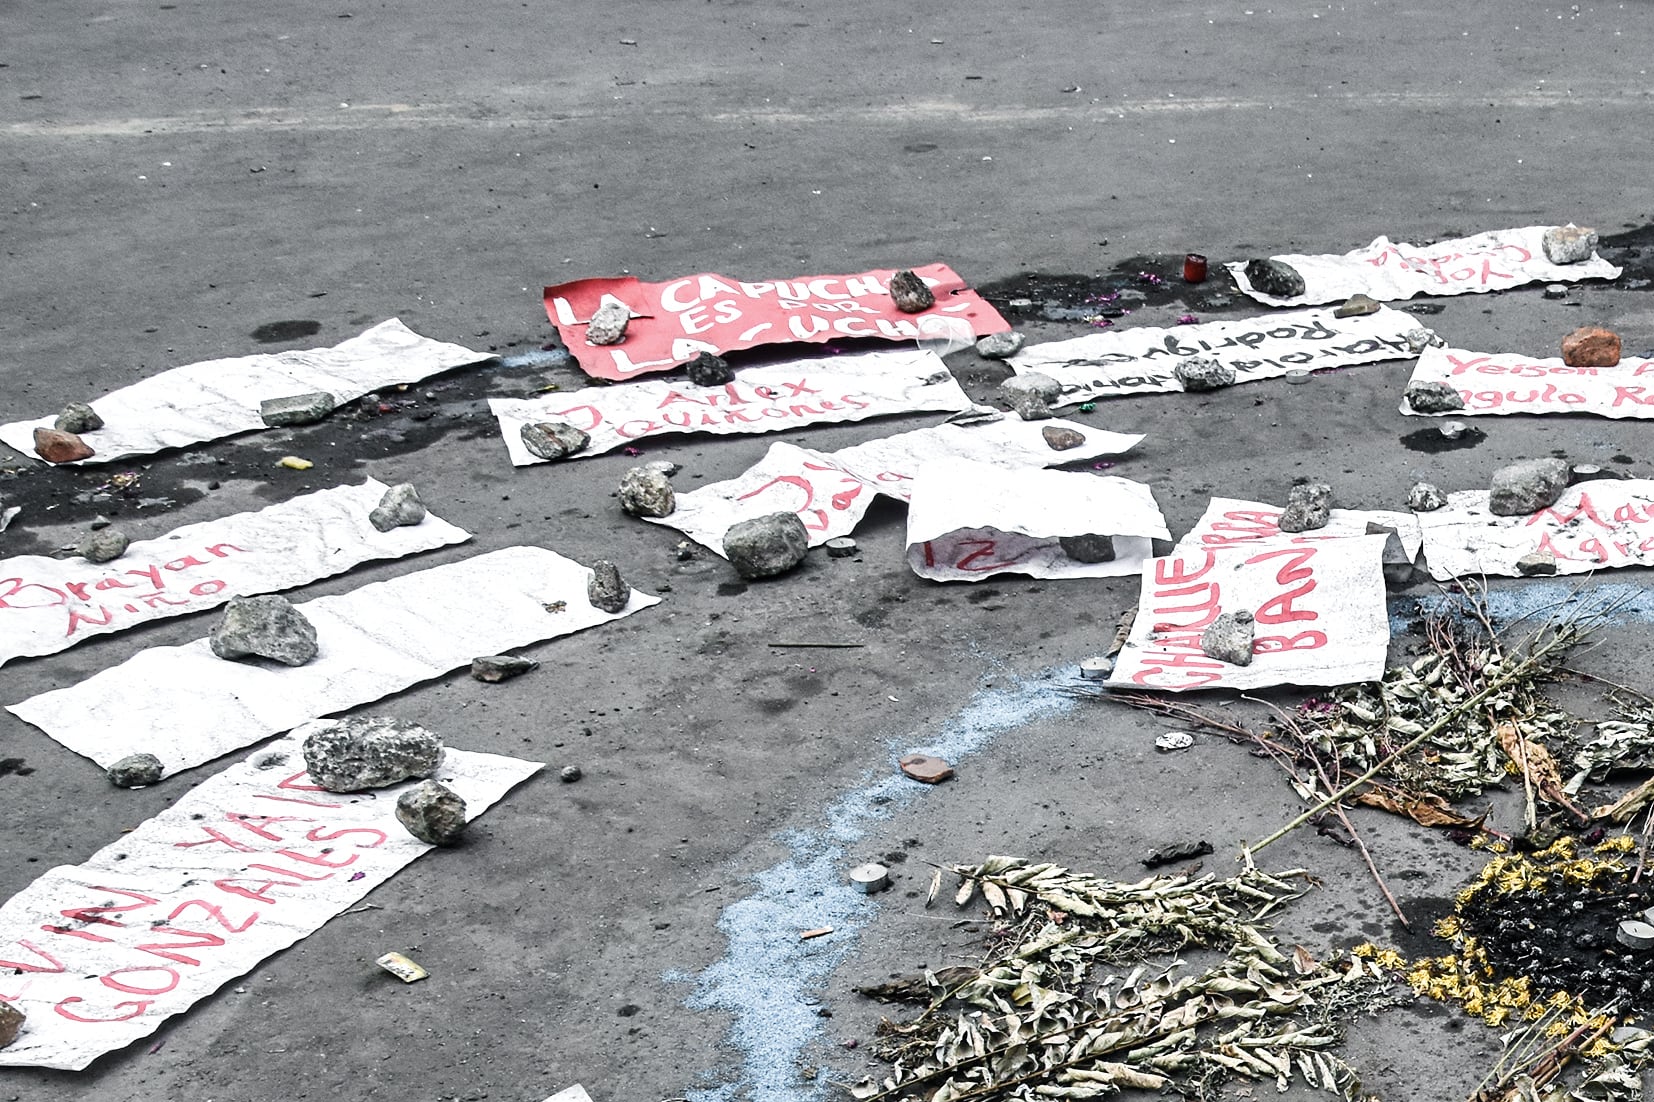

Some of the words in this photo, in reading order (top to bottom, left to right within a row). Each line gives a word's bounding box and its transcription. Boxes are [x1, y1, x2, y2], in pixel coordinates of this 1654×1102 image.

[680, 300, 742, 335] ES
[779, 298, 881, 317] POR
[611, 338, 720, 374] LA
[1452, 384, 1587, 410] ngulo
